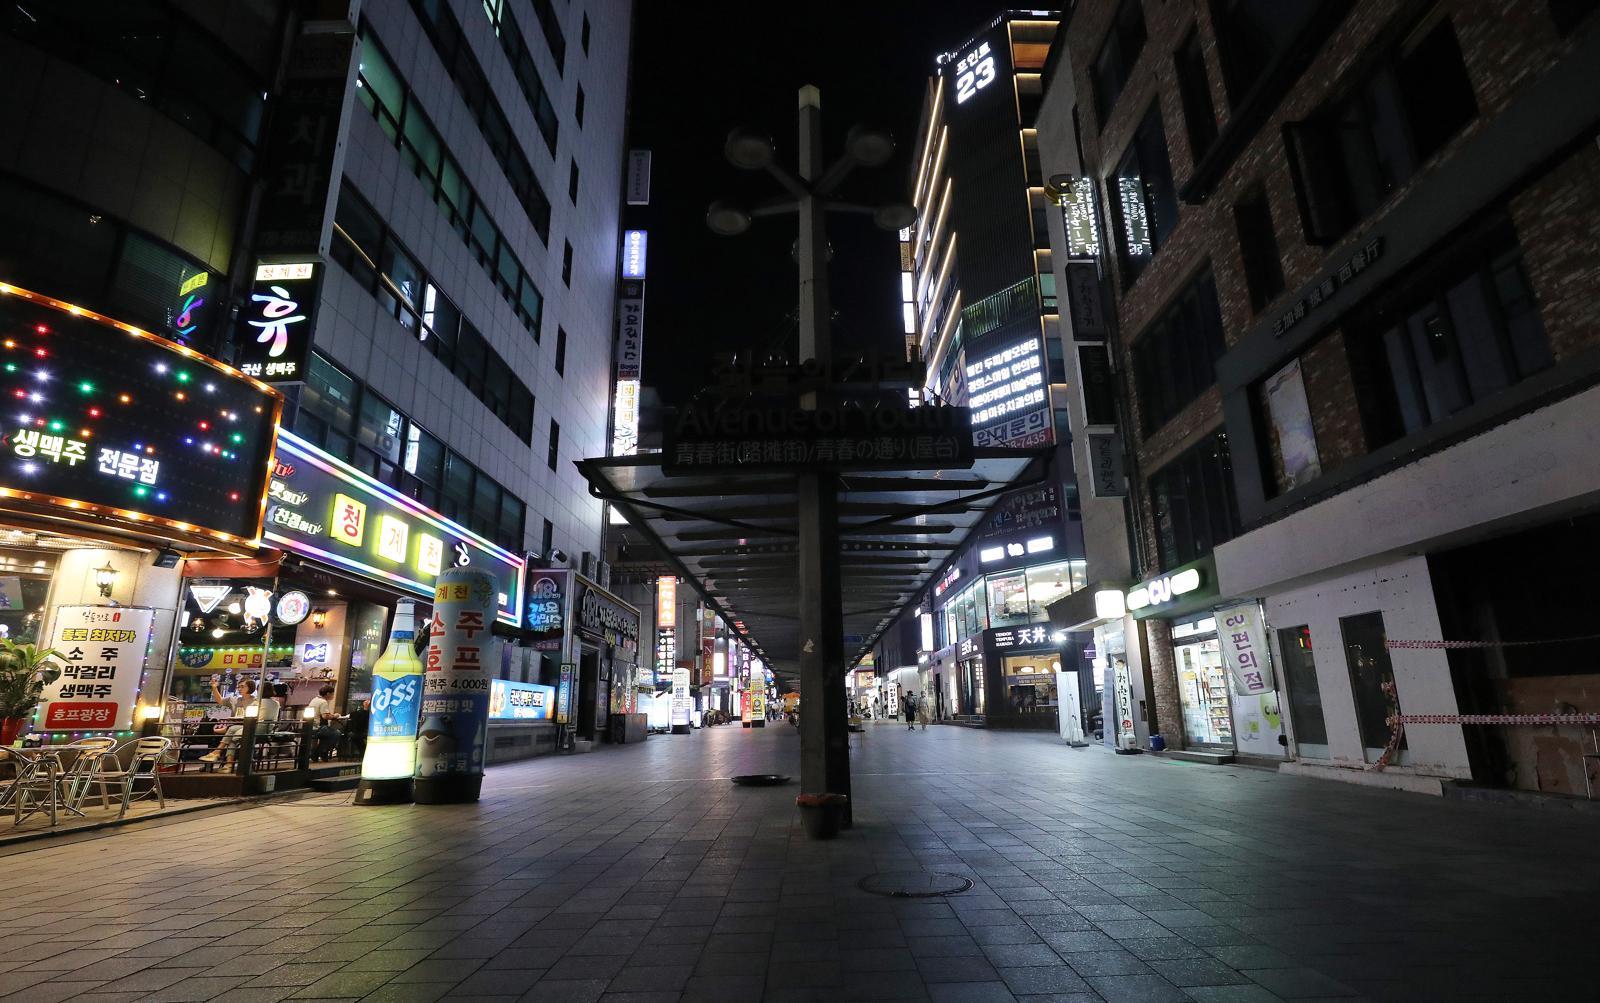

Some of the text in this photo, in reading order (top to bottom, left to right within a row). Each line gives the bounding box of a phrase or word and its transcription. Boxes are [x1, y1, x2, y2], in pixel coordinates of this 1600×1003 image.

[956, 42, 991, 76] 포인트
[956, 57, 995, 104] 23
[675, 398, 963, 434] Avenue of Youth
[976, 412, 1045, 447] 임대문의
[12, 428, 161, 486] 생맥주 전문점
[1226, 614, 1245, 627] CU
[90, 627, 137, 644] 최저가
[63, 664, 116, 680] 막걸리
[427, 645, 484, 672] 호프
[742, 653, 751, 677] BAR
[1231, 631, 1265, 690] 편의점
[59, 683, 113, 699] 생맥주
[52, 708, 110, 722] 호프광장
